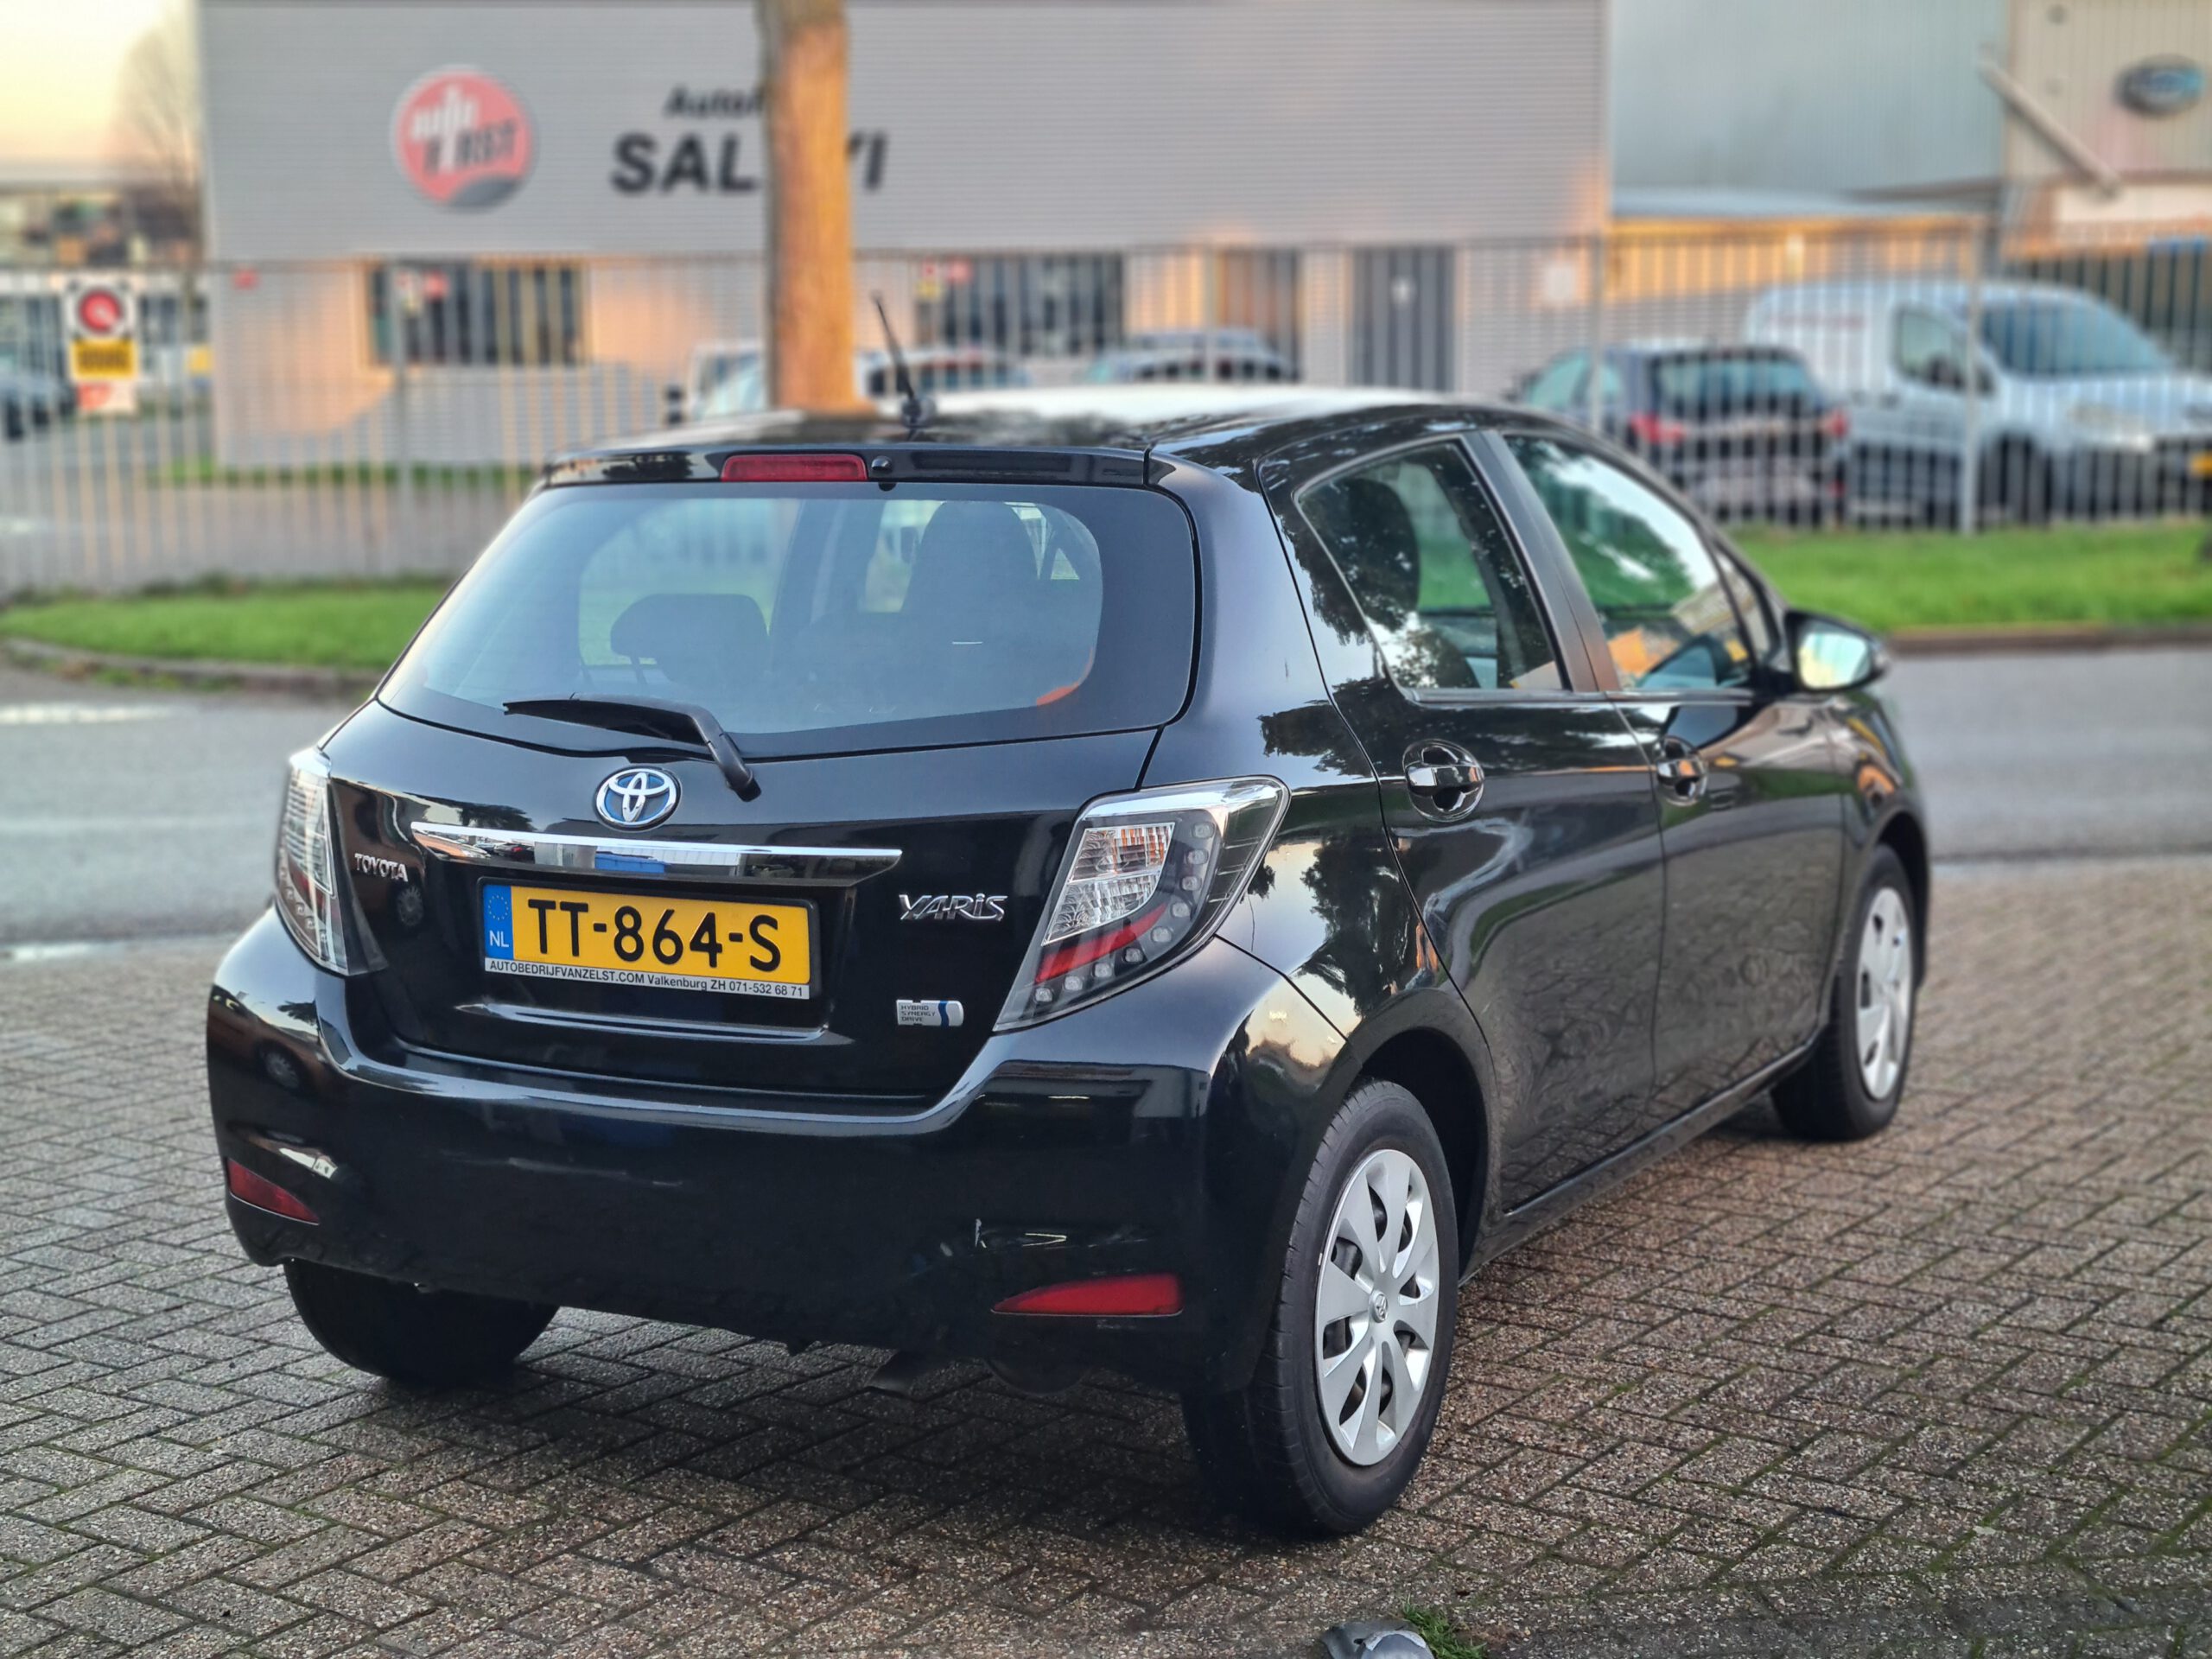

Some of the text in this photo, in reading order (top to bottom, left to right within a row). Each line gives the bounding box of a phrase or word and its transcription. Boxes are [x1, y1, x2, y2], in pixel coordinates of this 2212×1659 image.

[354, 853, 409, 882] TOYOTA
[489, 930, 510, 948] NL
[527, 898, 782, 973] TT-864-S
[490, 960, 803, 996] AUTOBEDRIJFVANZELST.COM Valkenburg ZH 071-532 68 71
